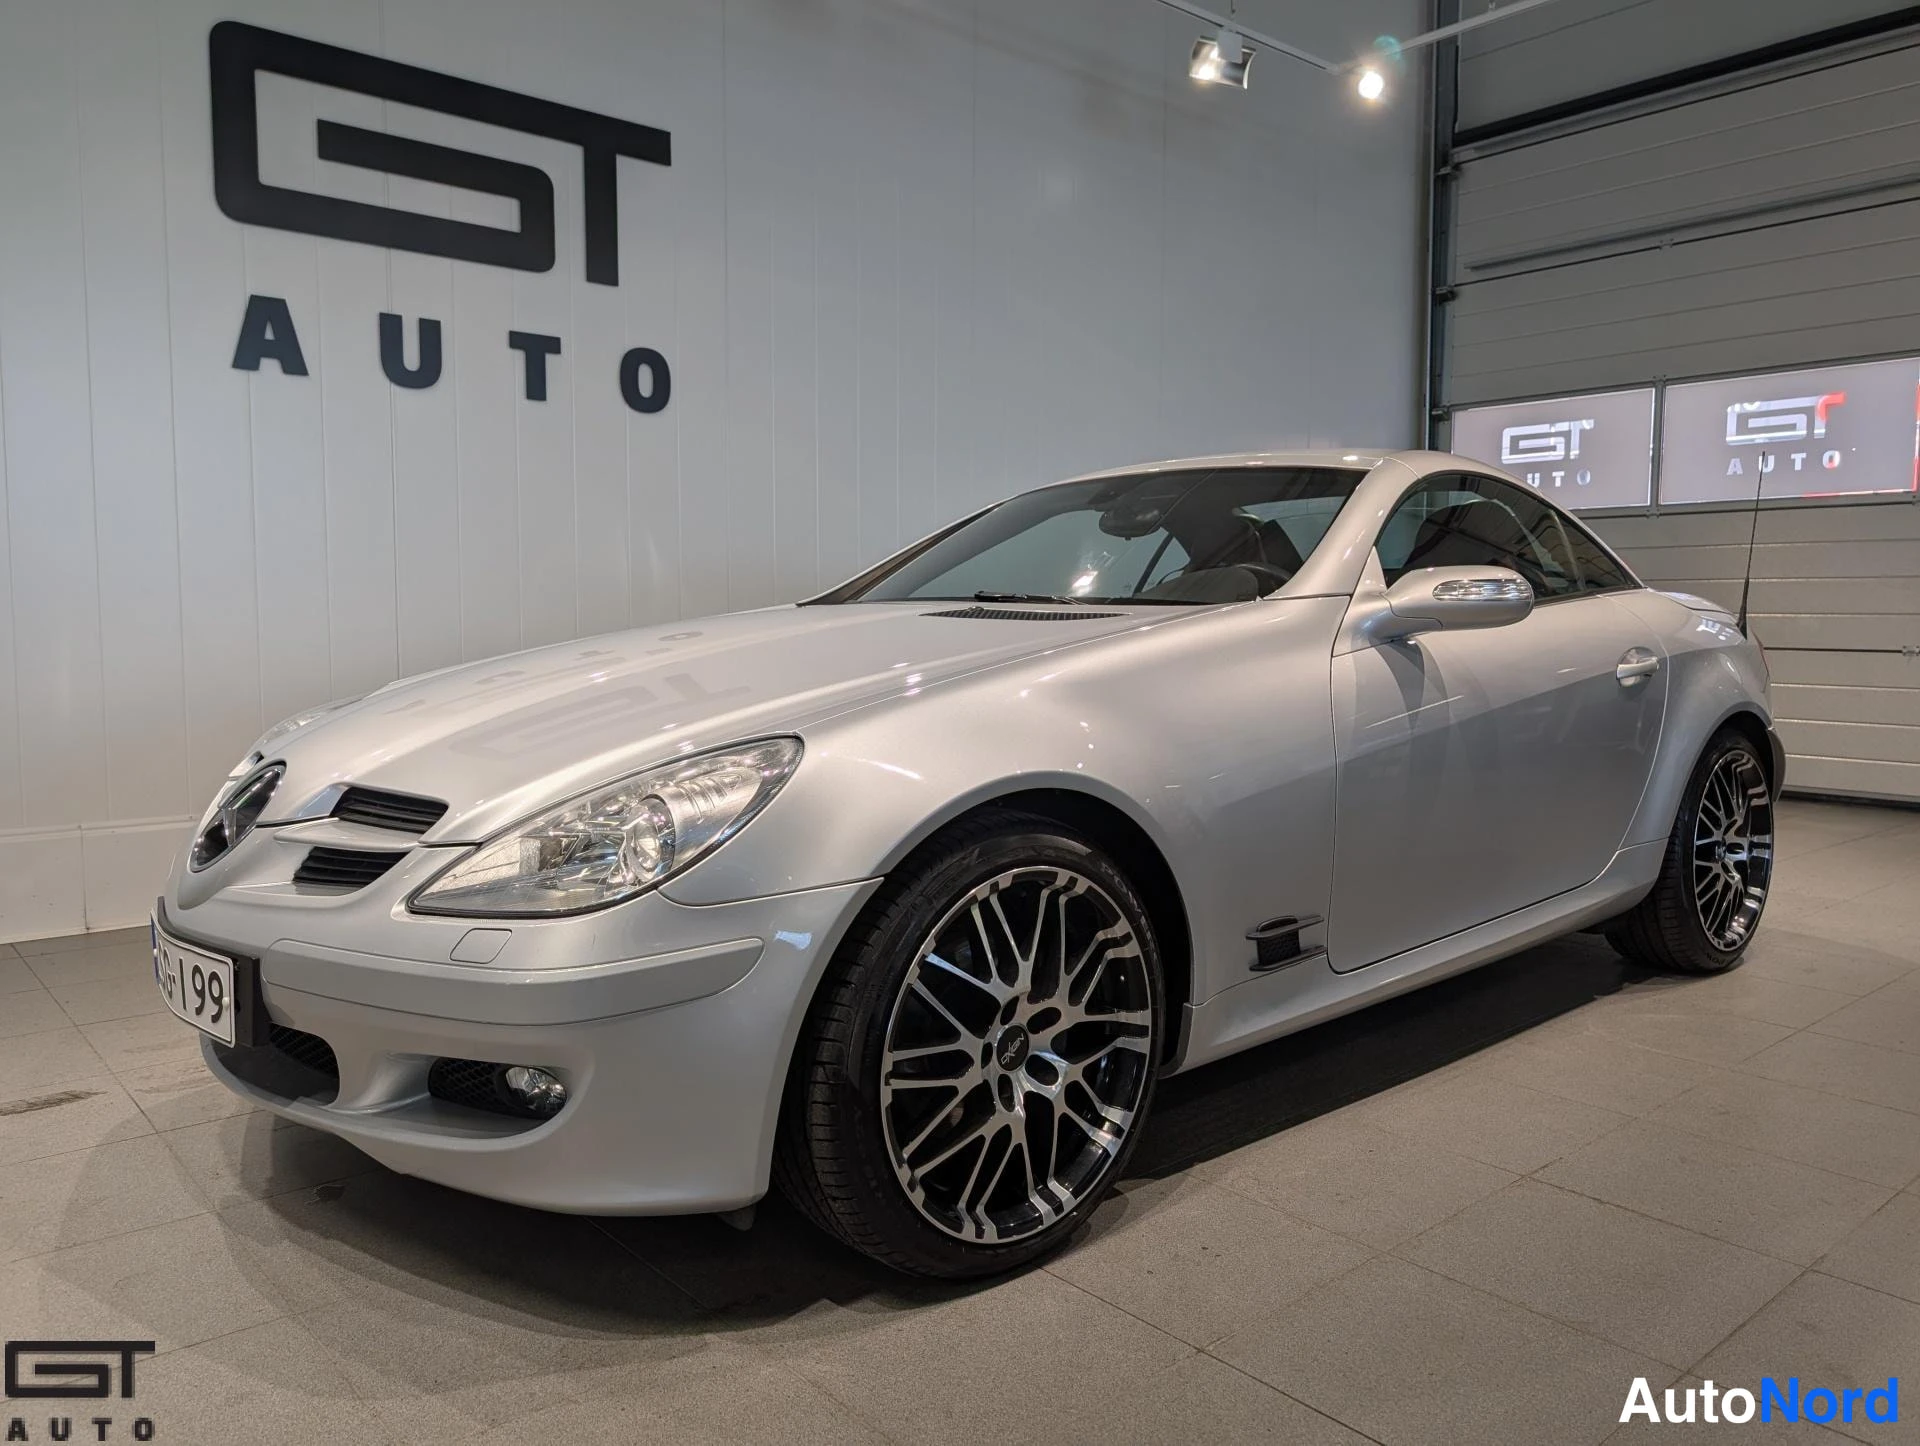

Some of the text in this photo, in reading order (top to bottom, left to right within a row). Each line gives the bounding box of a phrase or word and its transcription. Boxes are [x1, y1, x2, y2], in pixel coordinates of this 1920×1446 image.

[209, 20, 672, 287] GT
[232, 294, 671, 414] AUTO
[1501, 419, 1595, 464] GT
[1726, 391, 1846, 446] GT
[1526, 469, 1591, 489] UTO
[1726, 450, 1841, 476] AUTO
